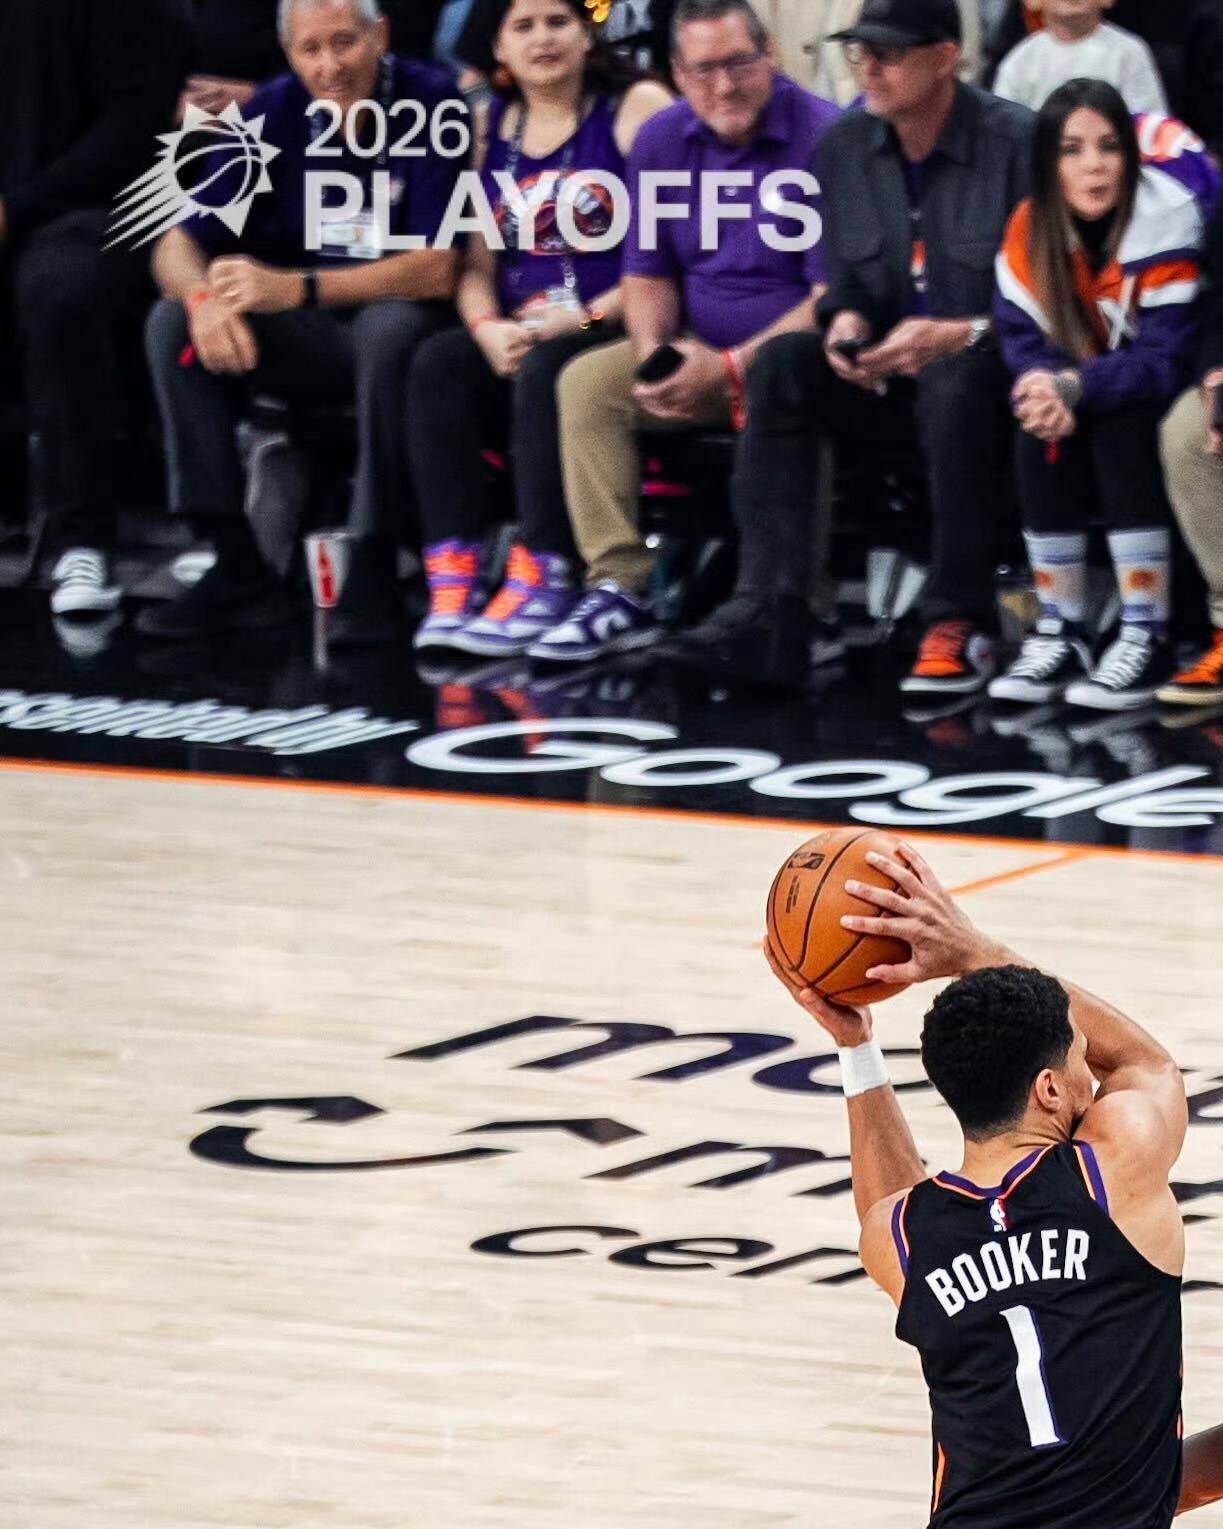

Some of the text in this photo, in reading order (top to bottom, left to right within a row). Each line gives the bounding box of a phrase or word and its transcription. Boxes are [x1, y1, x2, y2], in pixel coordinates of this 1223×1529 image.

[0, 688, 421, 756] sented by
[925, 1228, 1090, 1317] BOOKER
[999, 1304, 1069, 1449] 1
